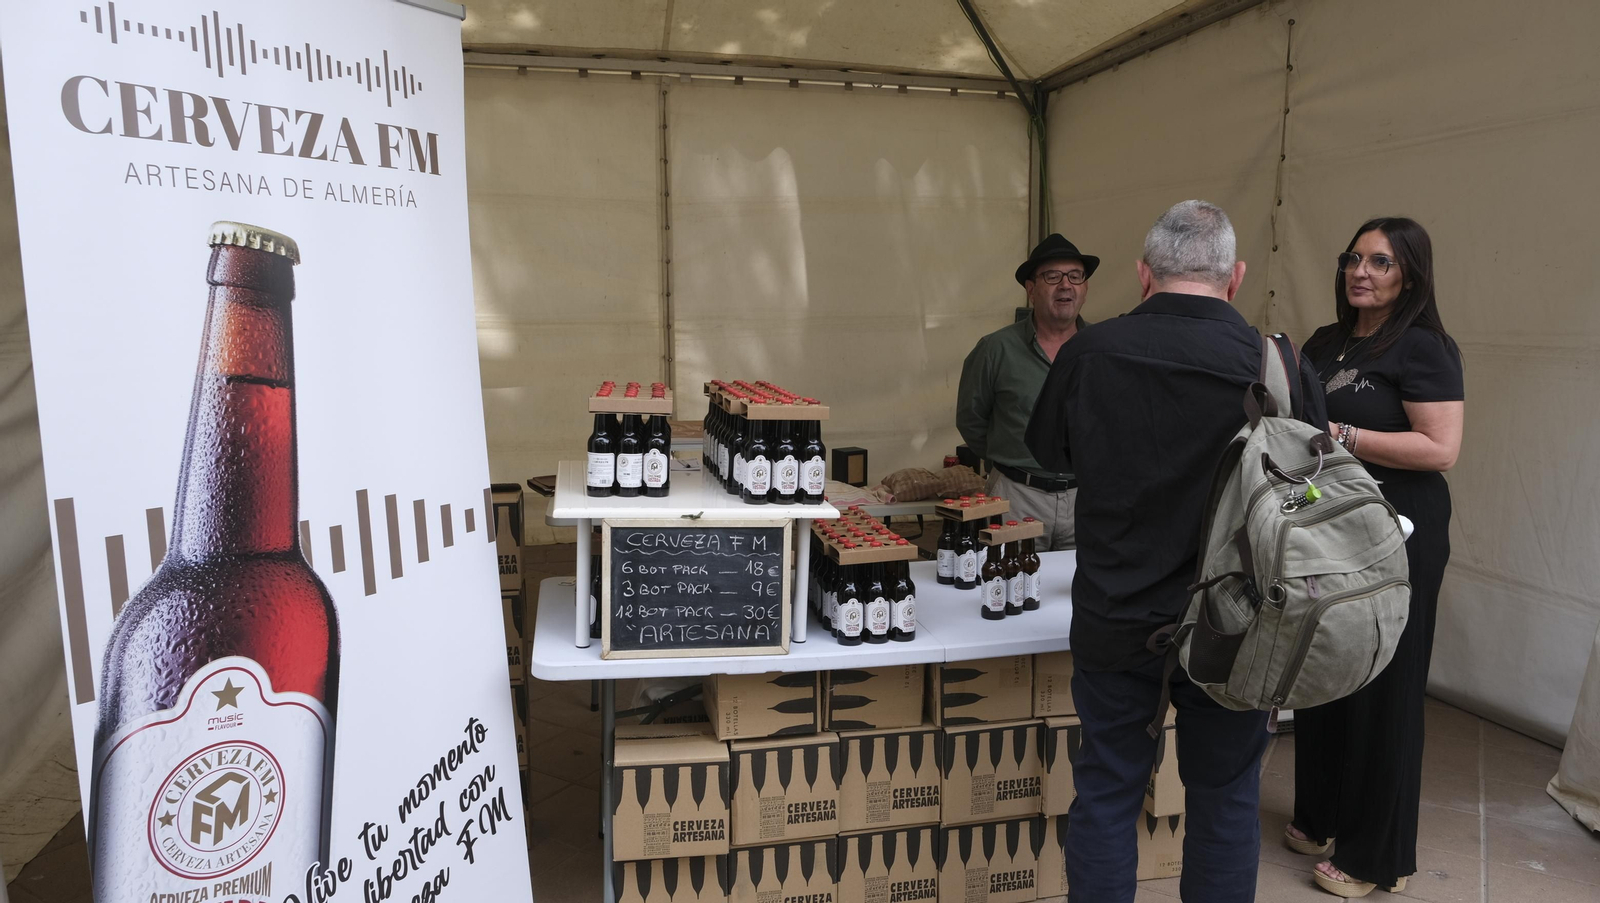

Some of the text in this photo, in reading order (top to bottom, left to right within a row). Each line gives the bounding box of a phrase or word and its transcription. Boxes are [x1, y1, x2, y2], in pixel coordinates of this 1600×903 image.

[61, 75, 441, 176] CERVEZA FM
[124, 162, 417, 208] ARTESANA DE ALMERÍA
[626, 532, 721, 550] CERVEZA
[621, 561, 633, 574] 6
[638, 566, 667, 575] BOT
[672, 564, 709, 576] PACK
[622, 580, 635, 597] 3
[639, 584, 672, 595] BOT
[677, 582, 713, 594] PACK
[615, 604, 634, 619] 12
[638, 604, 669, 617] BOT
[675, 605, 714, 619] PACK
[208, 712, 244, 725] music
[215, 722, 237, 731] FLAVOUR
[164, 749, 276, 804] CERVEZA FM
[996, 776, 1041, 791] CERVEZA
[358, 822, 388, 861] tu
[399, 717, 488, 824] momento
[893, 785, 940, 799] CERVEZA
[995, 786, 1042, 802] ARTESANA
[787, 799, 837, 814] CERVEZA
[892, 795, 940, 810] ARTESANA
[673, 819, 725, 831] CERVEZA
[786, 810, 837, 825] ARTESANA
[363, 801, 452, 903] libertad
[459, 764, 496, 812] con
[672, 830, 725, 843] ARTESANA
[162, 813, 274, 870] CERVEZA ARTESANA
[213, 861, 273, 898] PREMIUM
[990, 868, 1035, 884] CERVEZA
[890, 878, 936, 893] CERVEZA
[989, 878, 1035, 894] ARTESANA
[889, 888, 936, 903] ARTESANA
